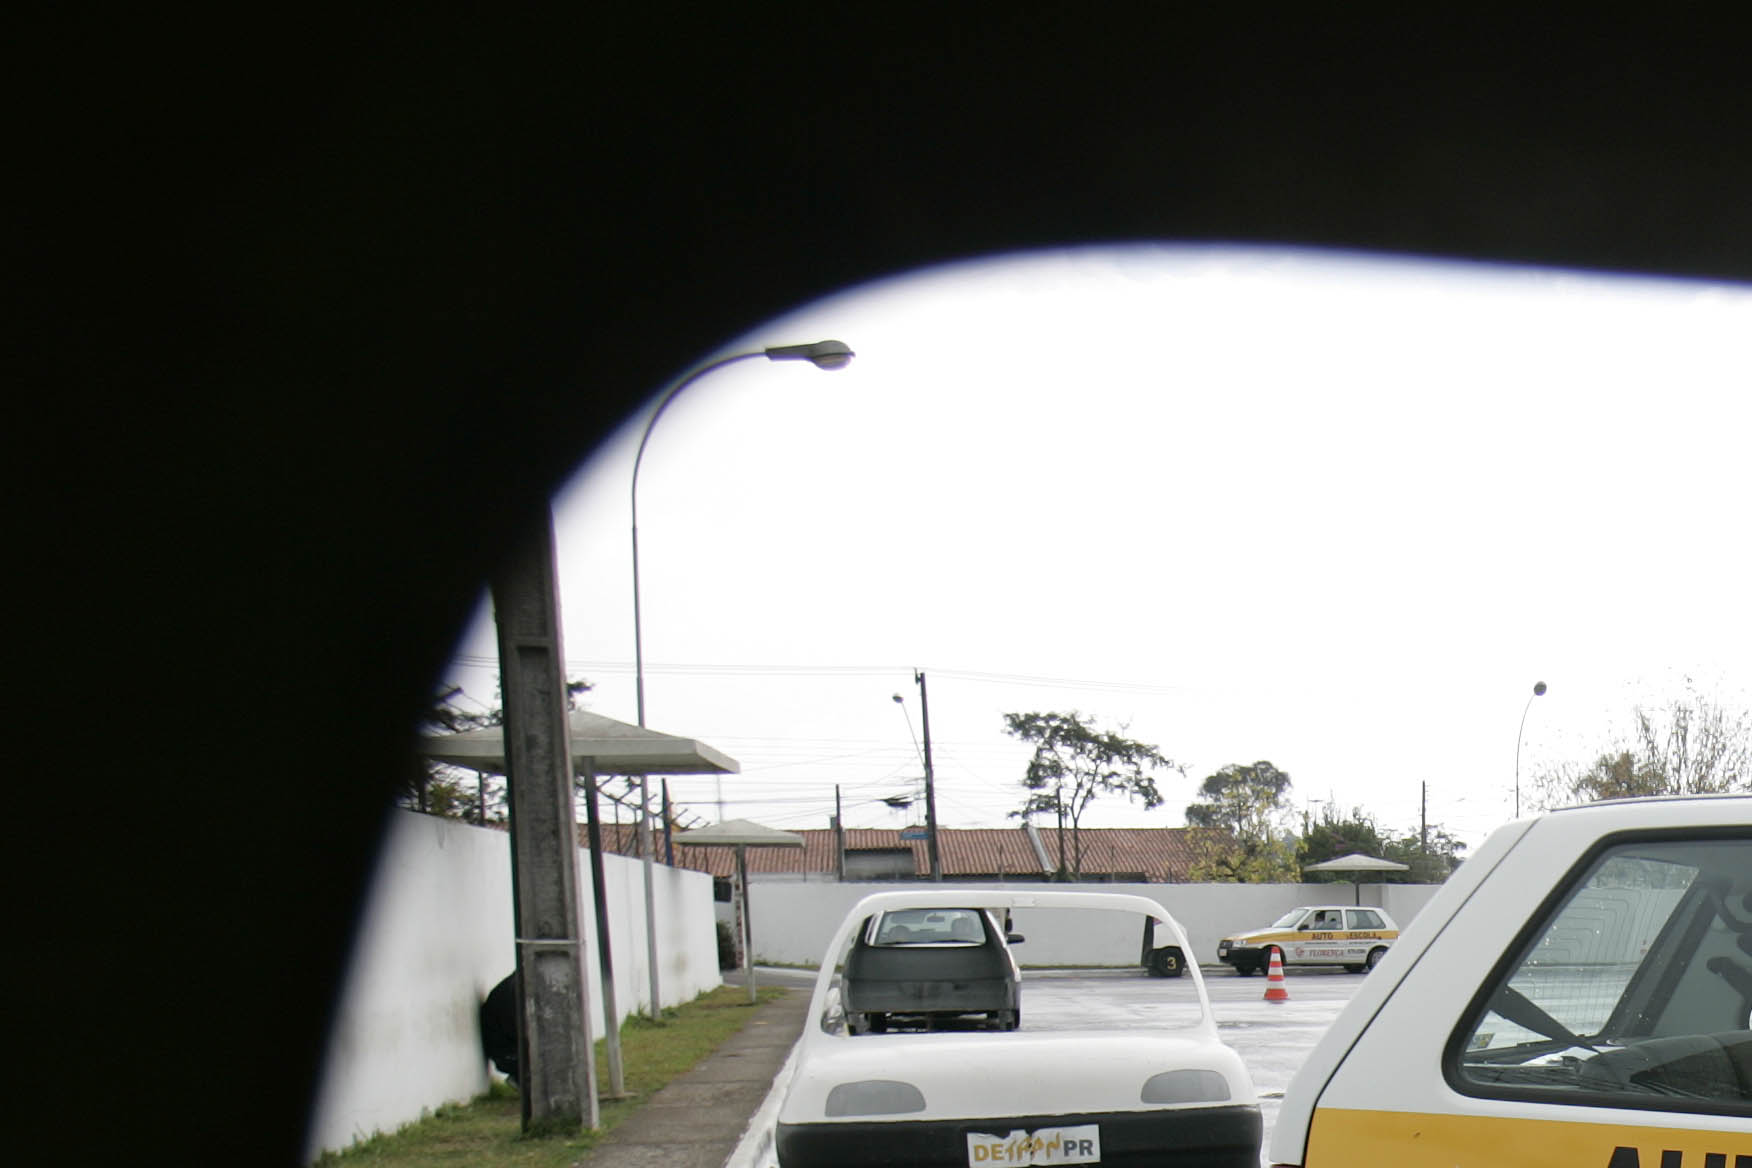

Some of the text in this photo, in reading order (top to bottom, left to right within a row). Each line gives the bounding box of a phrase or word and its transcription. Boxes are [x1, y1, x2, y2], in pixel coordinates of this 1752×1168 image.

[1312, 931, 1376, 940] AUTO ESCOLA
[1167, 956, 1177, 970] 3
[1063, 1139, 1094, 1157] PR
